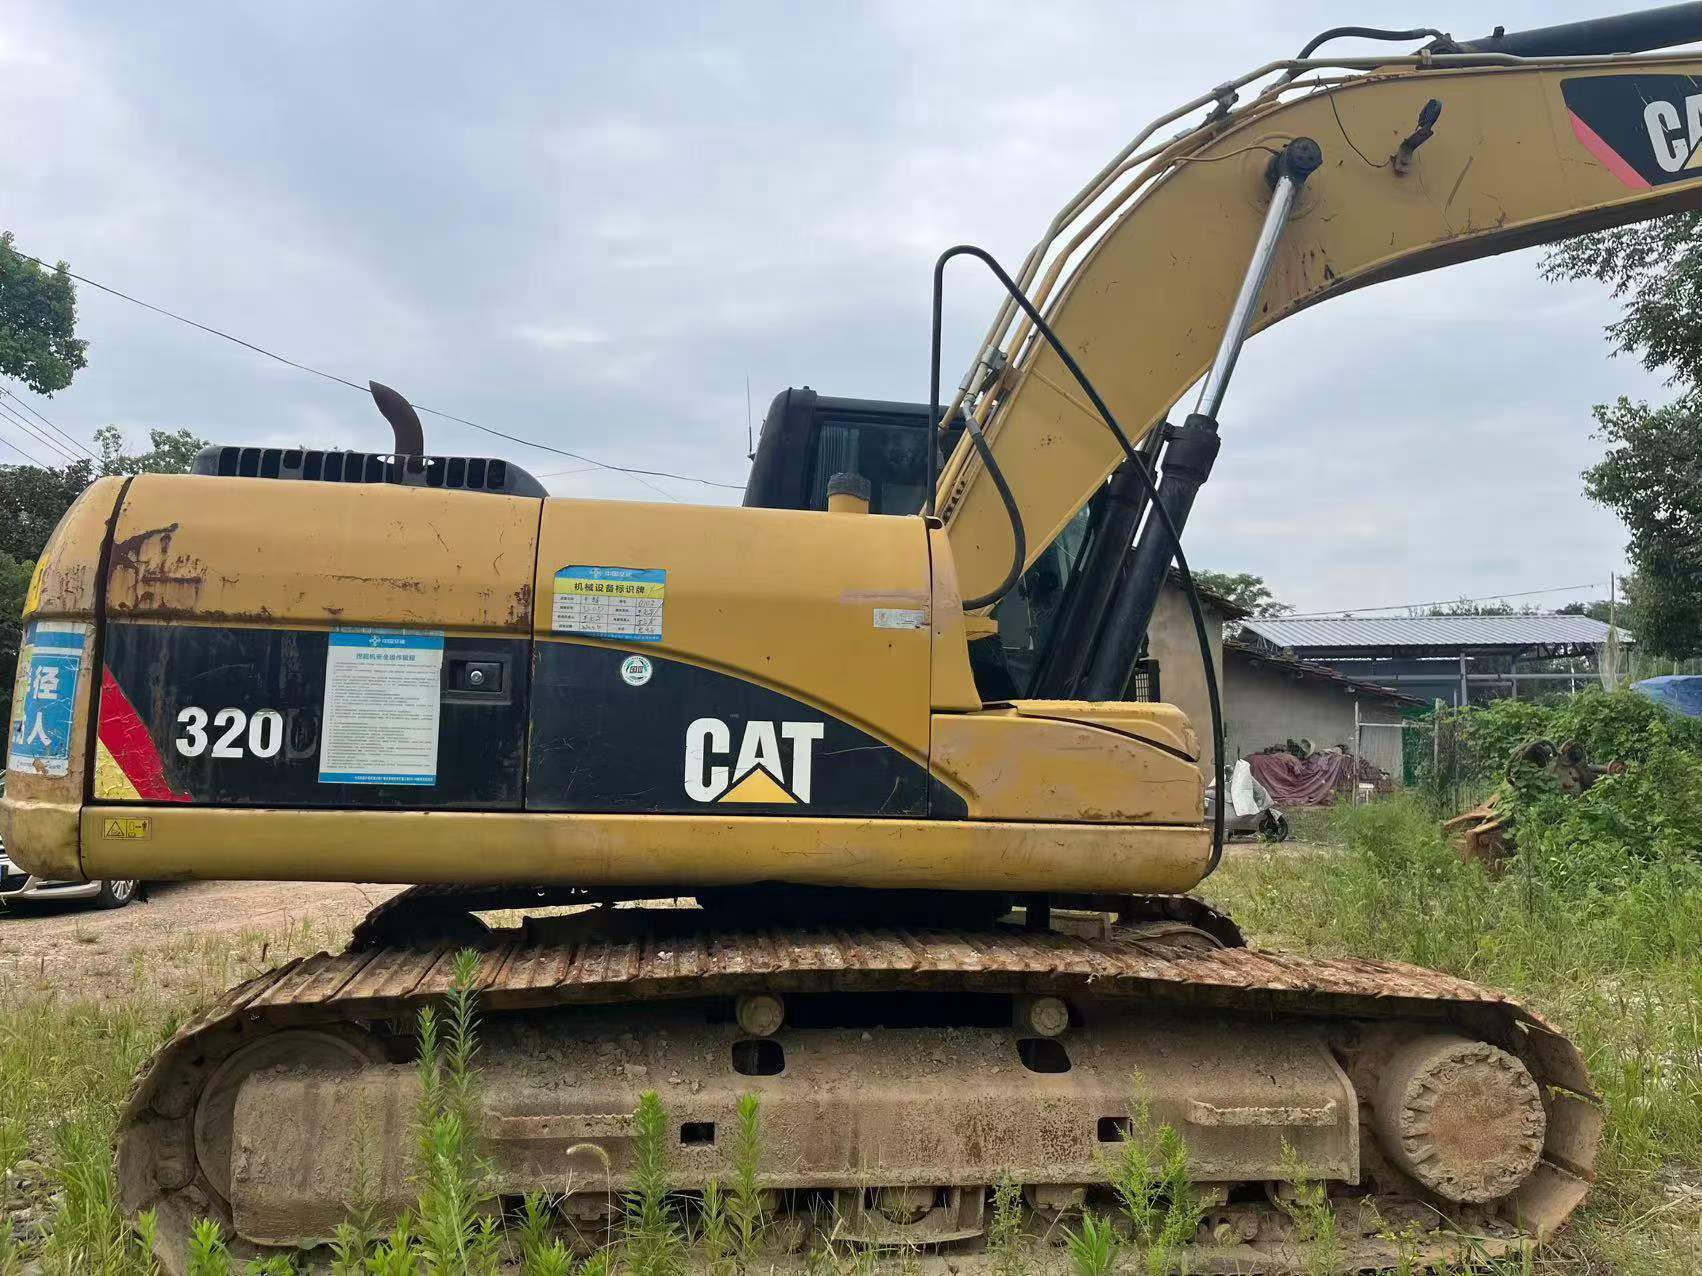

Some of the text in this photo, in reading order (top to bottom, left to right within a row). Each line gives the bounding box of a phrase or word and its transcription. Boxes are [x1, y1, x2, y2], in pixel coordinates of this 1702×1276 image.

[574, 582, 645, 594] 机械设备标识牌
[26, 666, 60, 700] 径
[175, 706, 283, 758] 320
[684, 717, 825, 804] CAT
